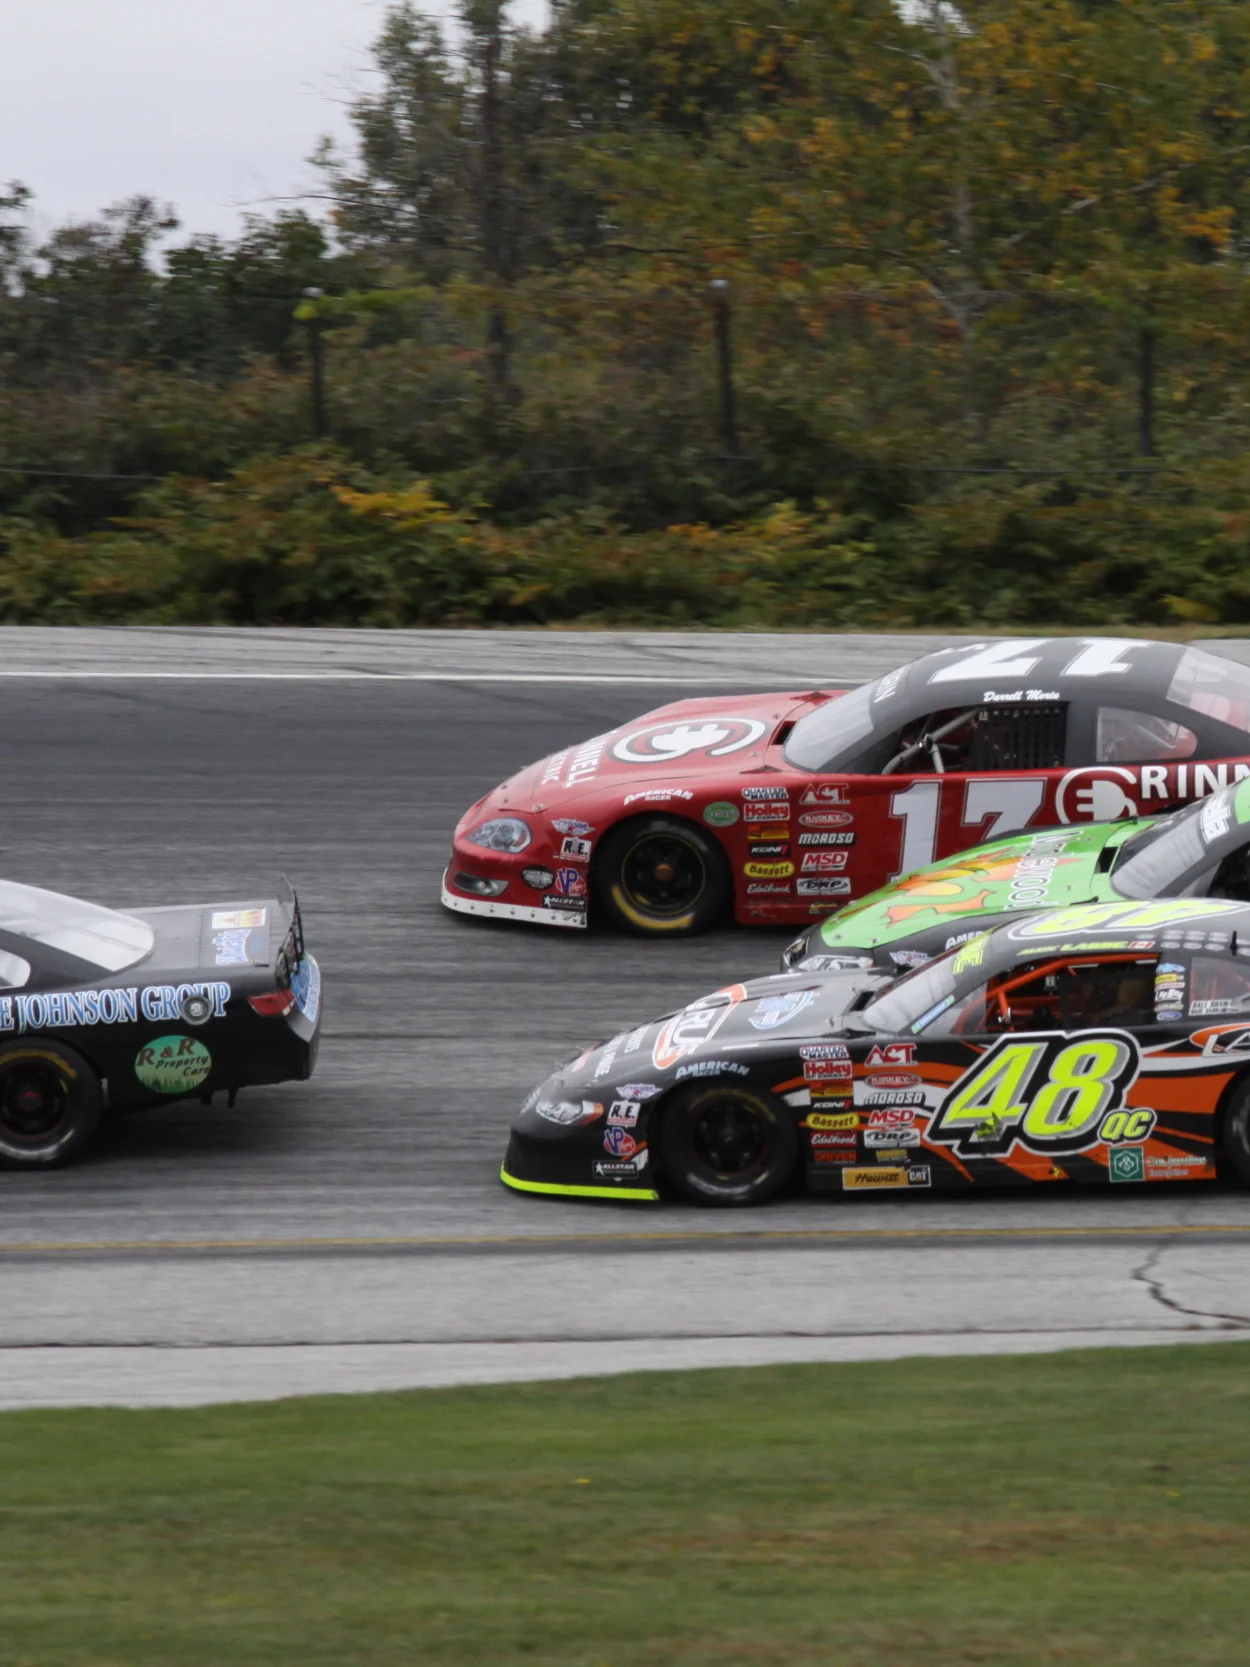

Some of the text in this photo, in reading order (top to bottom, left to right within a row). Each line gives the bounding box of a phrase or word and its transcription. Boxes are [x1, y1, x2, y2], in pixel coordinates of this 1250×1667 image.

[984, 690, 1060, 702] Darrell Morin
[624, 789, 694, 806] AMERICAN
[800, 783, 850, 803] ACT
[745, 804, 788, 819] Holley
[799, 833, 855, 844] MOROSO
[801, 854, 846, 868] MSD
[750, 864, 789, 876] Bassett
[558, 868, 578, 892] VP
[747, 884, 790, 894] Edelbrock
[551, 897, 584, 905] ALLSTAR
[15, 987, 138, 1034] JOHNSON
[138, 1037, 197, 1067] R & R
[864, 1045, 917, 1066] ACT
[156, 1055, 209, 1069] Property
[183, 1066, 210, 1077] Care
[676, 1062, 750, 1080] AMERICAN
[805, 1062, 851, 1078] Holley
[936, 1037, 1131, 1142] 48
[812, 1115, 854, 1126] Bassett
[869, 1111, 915, 1125] MSD
[1101, 1112, 1151, 1139] QC
[604, 1128, 625, 1154] VP
[811, 1134, 856, 1145] Edelbrock
[909, 1171, 927, 1183] CAT
